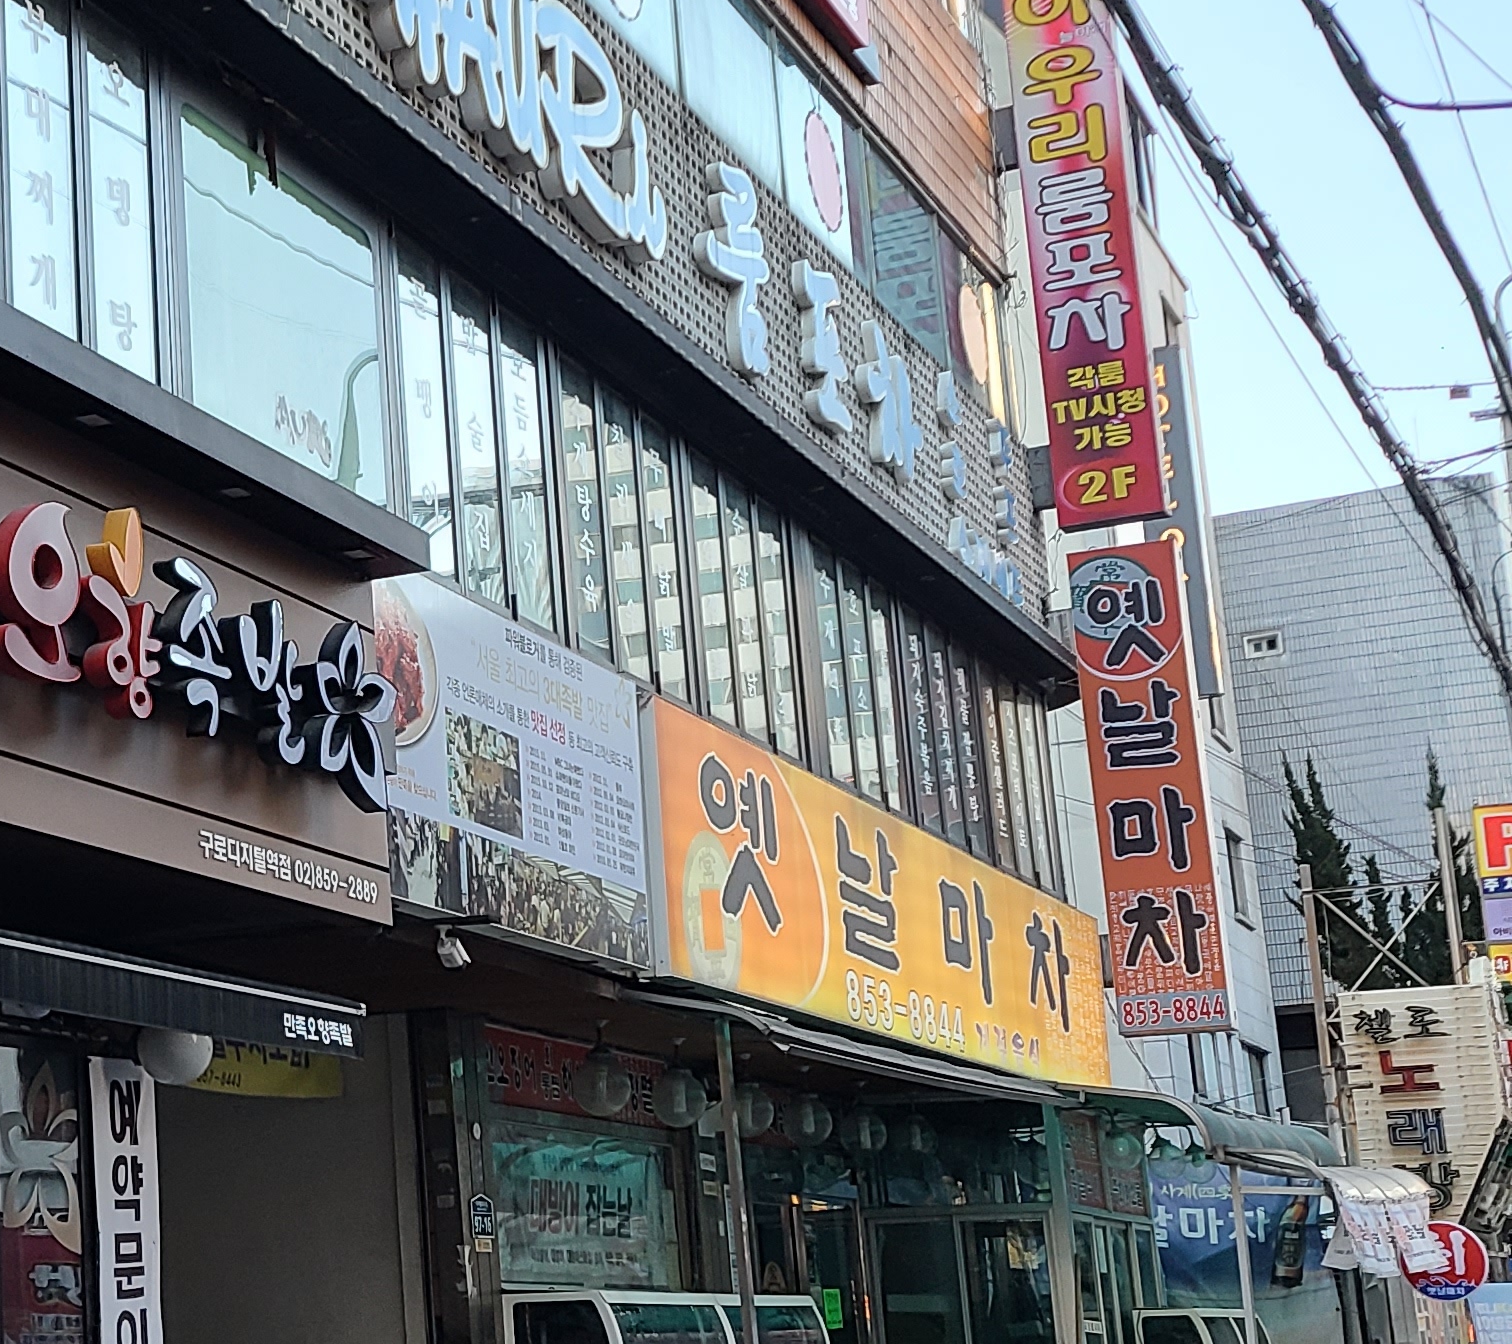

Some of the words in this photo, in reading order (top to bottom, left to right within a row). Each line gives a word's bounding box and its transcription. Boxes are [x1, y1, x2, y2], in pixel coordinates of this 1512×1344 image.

[1052, 387, 1147, 425] TV시청
[1073, 422, 1134, 452] 가능
[1076, 464, 1137, 508] 2F
[542, 676, 584, 723] 3대족발
[530, 709, 549, 738] 맛집
[548, 718, 567, 746] 선정
[1086, 578, 1210, 976] 옛날마차
[199, 829, 292, 882] 구로디지털역점
[293, 857, 379, 906] 02)859-2889
[698, 752, 1071, 1034] 옛날마차
[283, 1011, 354, 1048] 만족오향족발
[844, 969, 967, 1055] 853-8844
[1122, 993, 1226, 1027] 853-8844
[1354, 1005, 1452, 1044] 첼로
